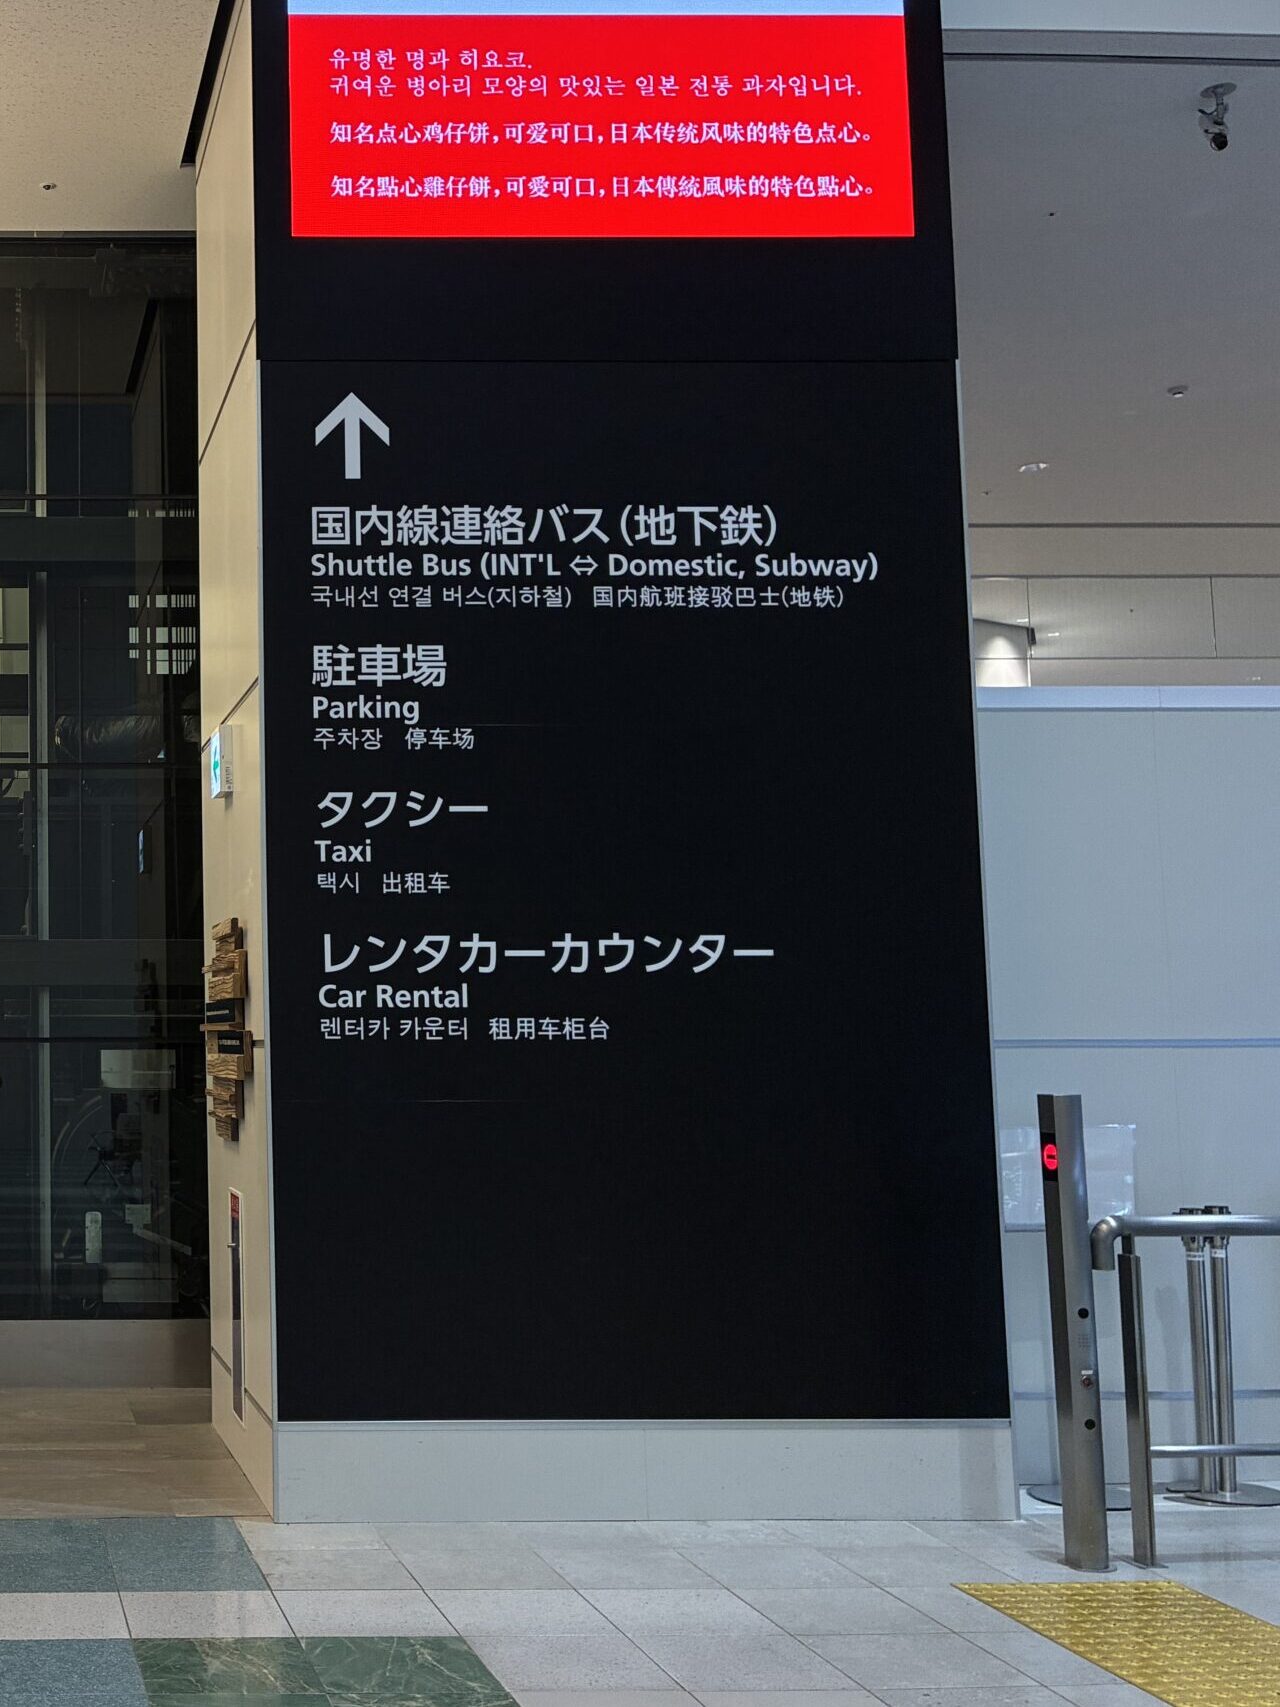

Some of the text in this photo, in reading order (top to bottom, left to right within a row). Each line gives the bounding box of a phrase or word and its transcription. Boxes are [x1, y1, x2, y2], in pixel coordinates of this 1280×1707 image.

[329, 48, 532, 71] 유명한 명과 히요코.
[330, 74, 861, 98] 귀여운 병아리 모양의 맛있는 일본 전통 과자입니다.
[311, 503, 778, 548] 国内線連絡バス（地下鉄）
[311, 551, 879, 583] Shuttle Bus (INT'L Domestic, Subway)
[310, 585, 572, 608] 국내선 연결 버스(지하철)
[593, 585, 845, 608] 国内航班接驳巴士(地铁)
[311, 643, 447, 688] 駐車場
[312, 695, 420, 725] Parking
[313, 727, 383, 751] 주차장
[404, 727, 475, 750] 停车场
[317, 790, 489, 829] タクシー
[314, 838, 373, 863] Taxi
[317, 871, 361, 894] 택시
[382, 871, 451, 894] 出租车
[322, 932, 776, 974] レンタカーカウンター
[318, 983, 469, 1009] Car Rental
[320, 1016, 469, 1041] 렌터카 카운터
[488, 1016, 611, 1041] 租用车柜台
